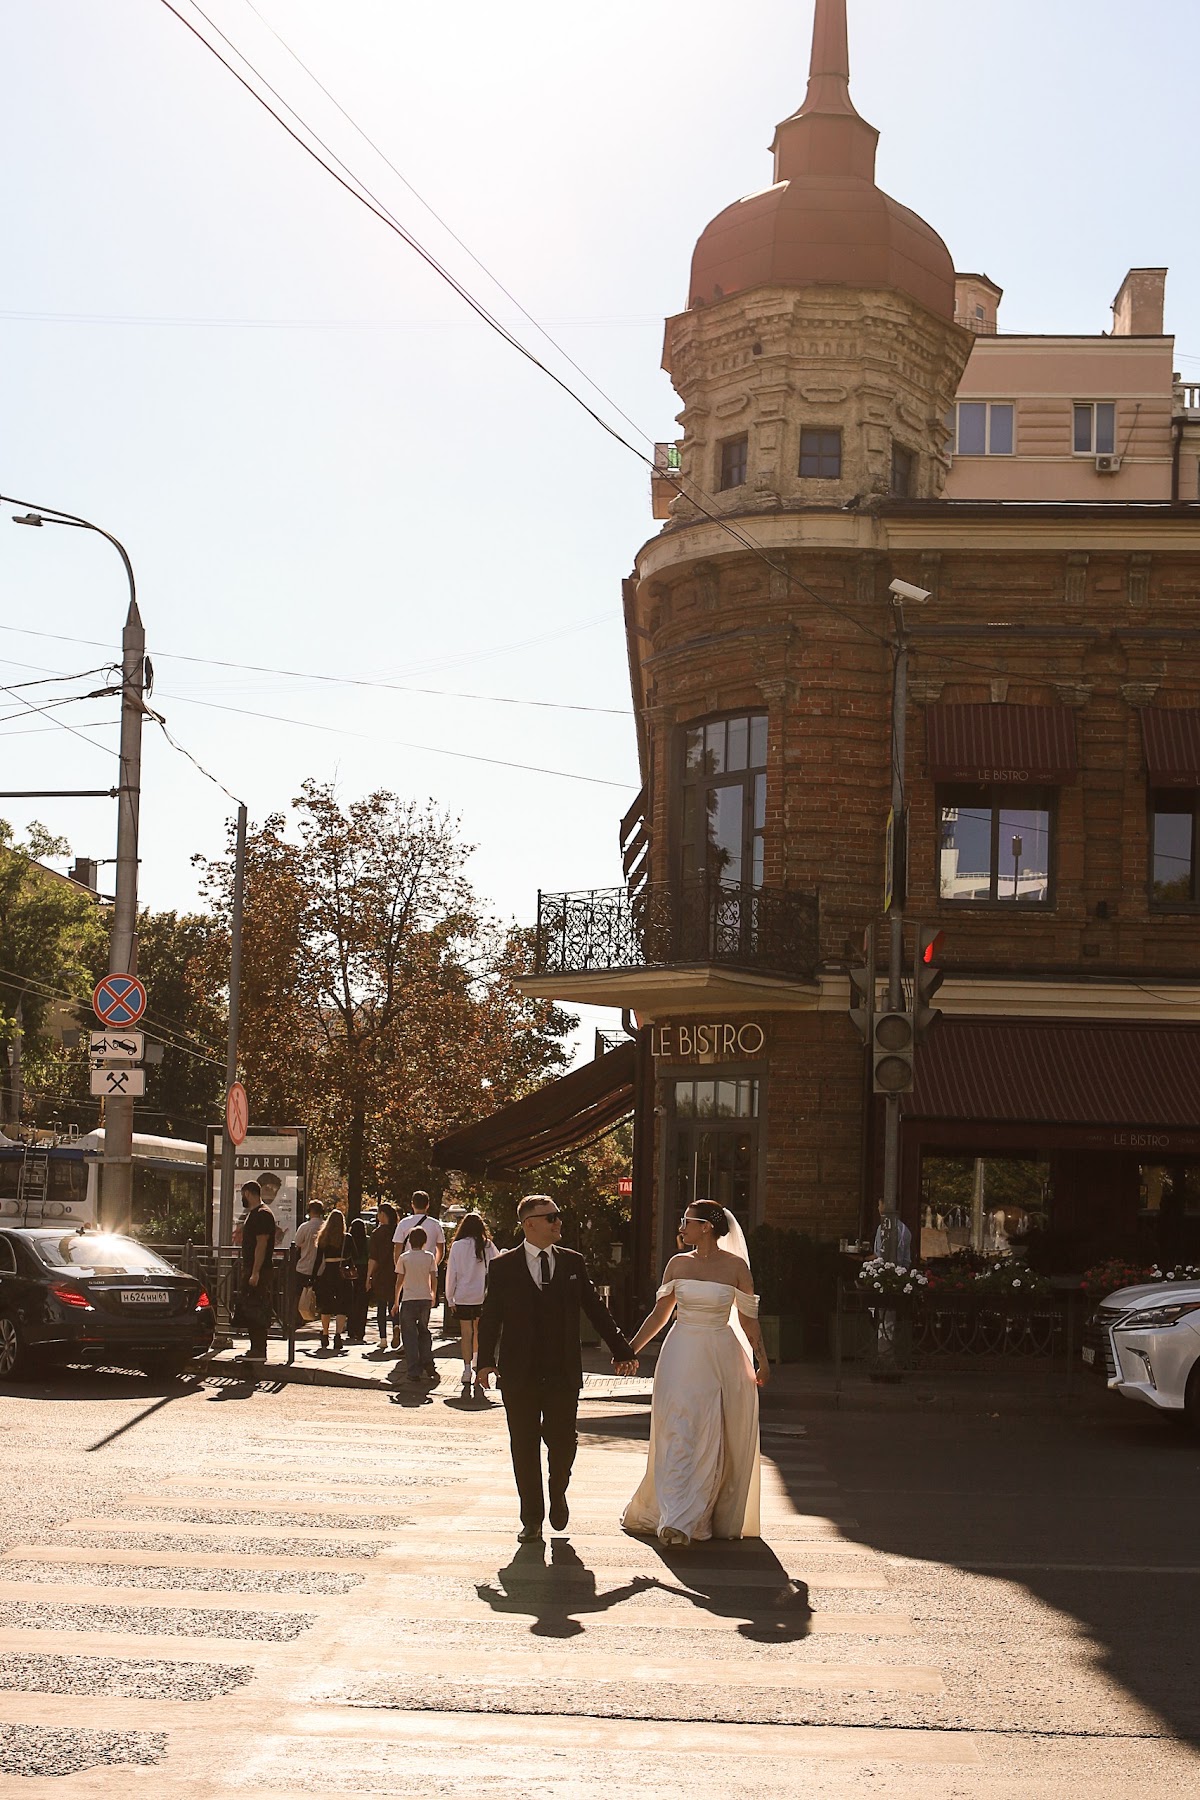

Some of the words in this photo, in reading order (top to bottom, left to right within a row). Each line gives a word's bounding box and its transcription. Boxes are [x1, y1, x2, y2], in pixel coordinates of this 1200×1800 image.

[978, 770, 990, 780] LE
[993, 770, 1029, 781] BISTRO
[650, 1026, 671, 1057] LE
[679, 1023, 764, 1056] BISTRO
[1113, 1133, 1126, 1145] LE
[1130, 1134, 1169, 1147] BISTRO
